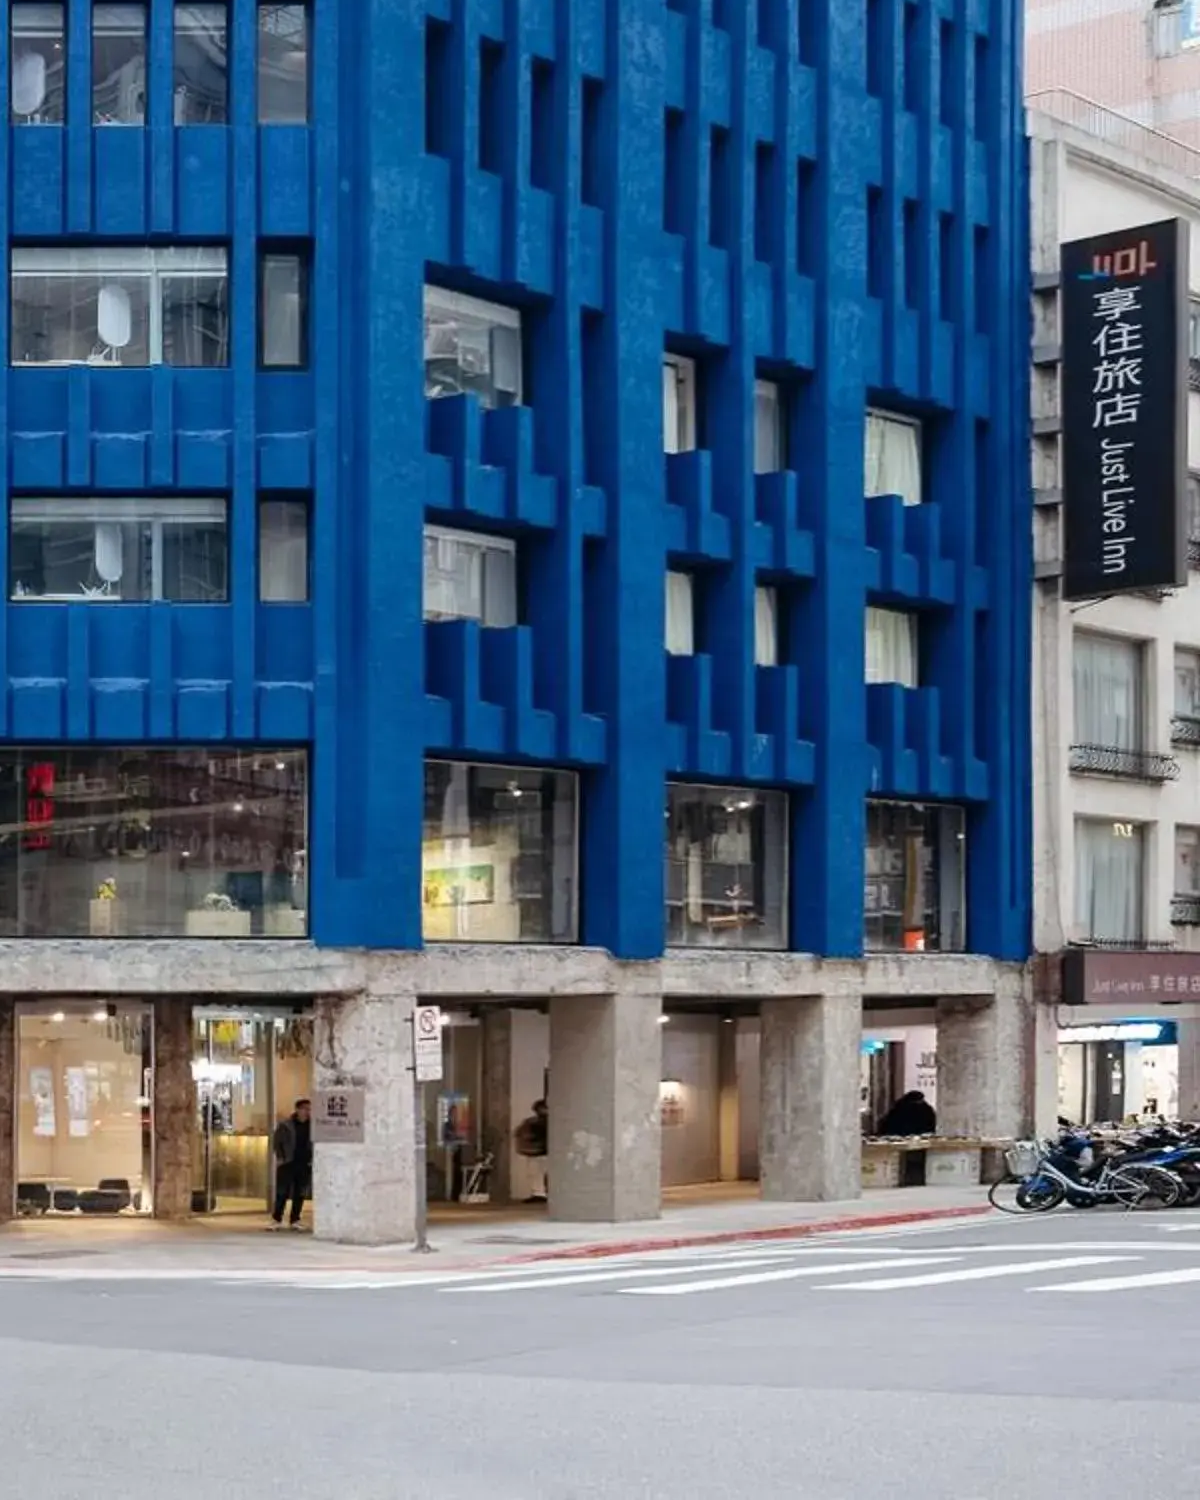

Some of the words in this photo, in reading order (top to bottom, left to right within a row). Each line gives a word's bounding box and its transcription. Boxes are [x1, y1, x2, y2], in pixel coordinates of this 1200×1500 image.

[1092, 285, 1142, 429] 享住旅店
[1101, 437, 1135, 485] Just
[1102, 487, 1135, 533] Live
[1103, 536, 1136, 575] Inn
